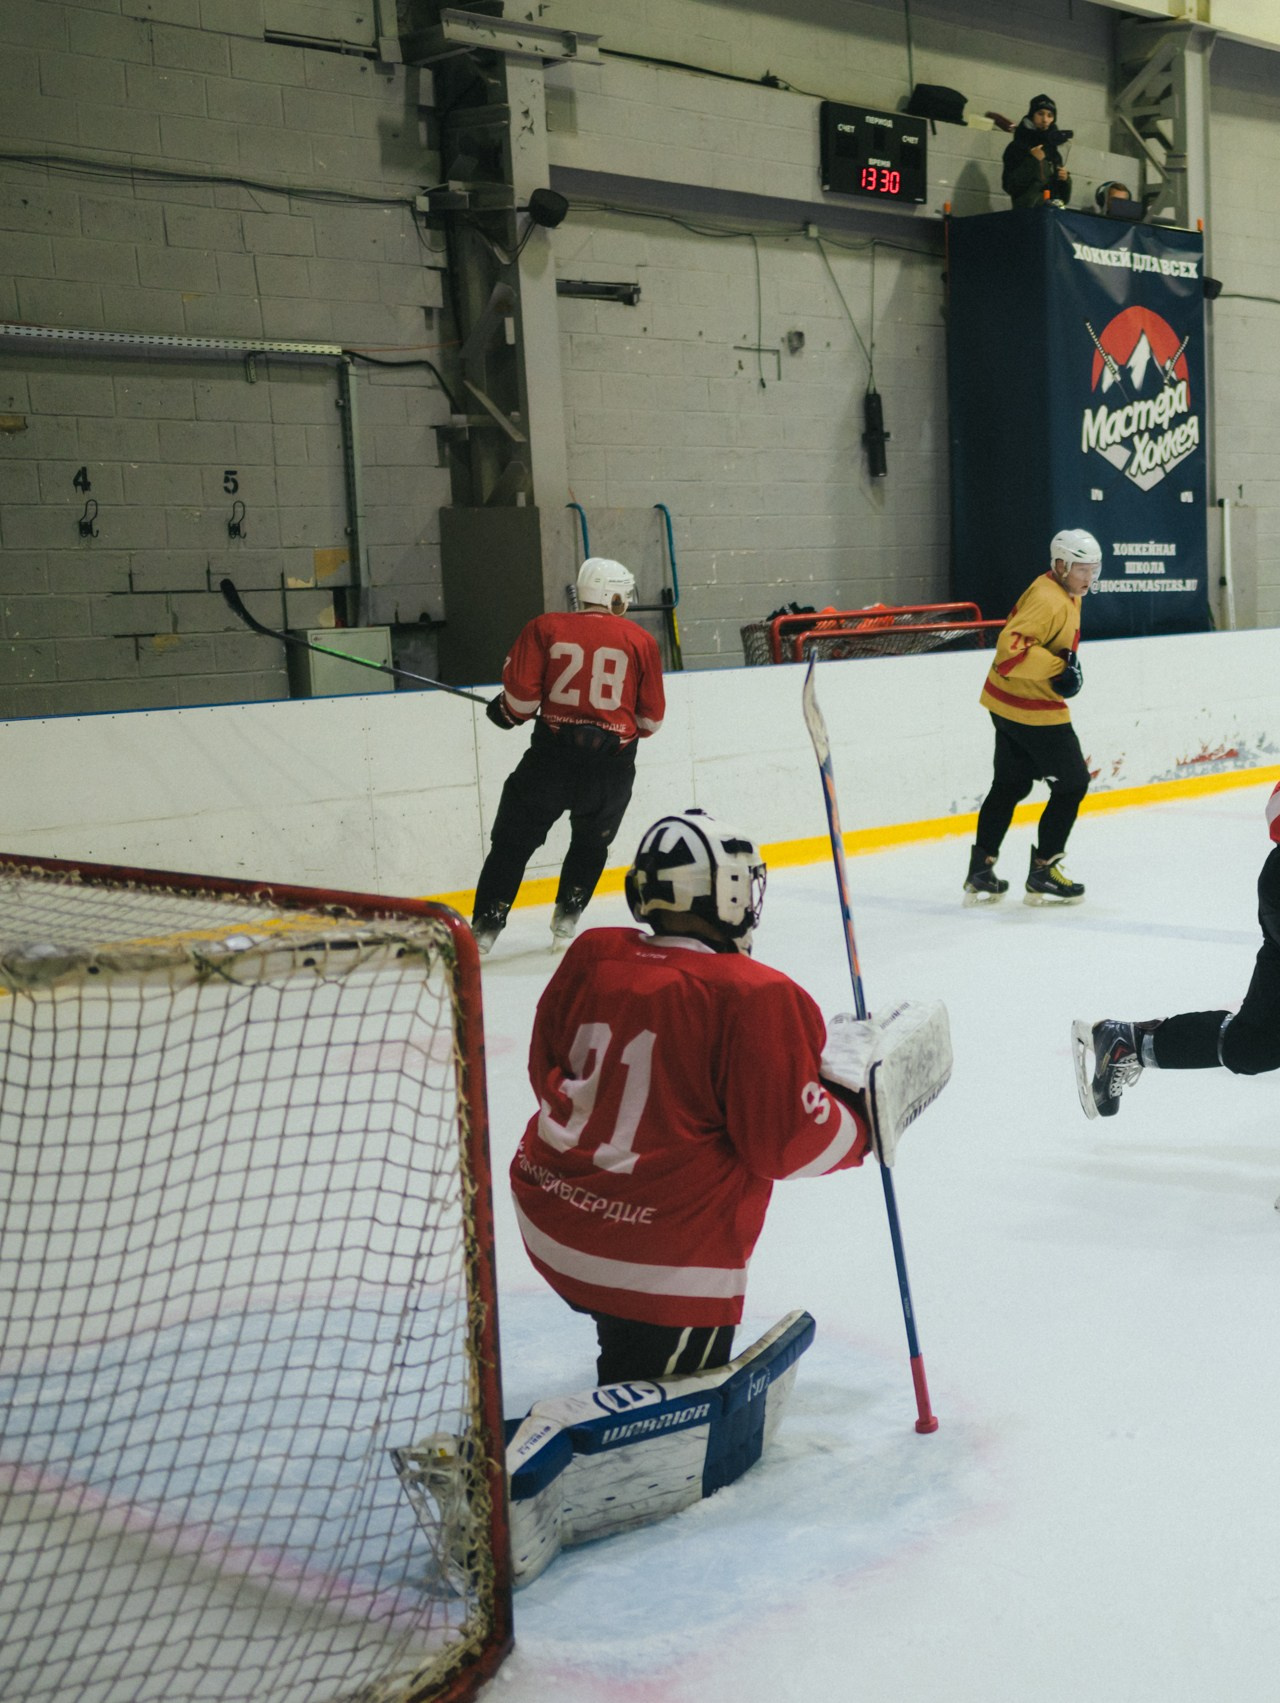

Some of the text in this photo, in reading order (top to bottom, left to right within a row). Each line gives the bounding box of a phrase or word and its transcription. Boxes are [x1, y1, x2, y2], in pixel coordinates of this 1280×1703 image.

[1072, 243, 1131, 268] ХОККЕЙ
[1160, 259, 1199, 279] ВСЕХ
[1082, 380, 1188, 453] Мастера
[1130, 415, 1200, 477] Хоккея
[73, 466, 91, 494] 4
[223, 470, 239, 494] 5
[1112, 540, 1177, 556] ХОККЕЙНАЯ
[1124, 561, 1166, 574] ШКОЛА
[549, 642, 629, 711] 28
[602, 1403, 711, 1445] WARRIOR
